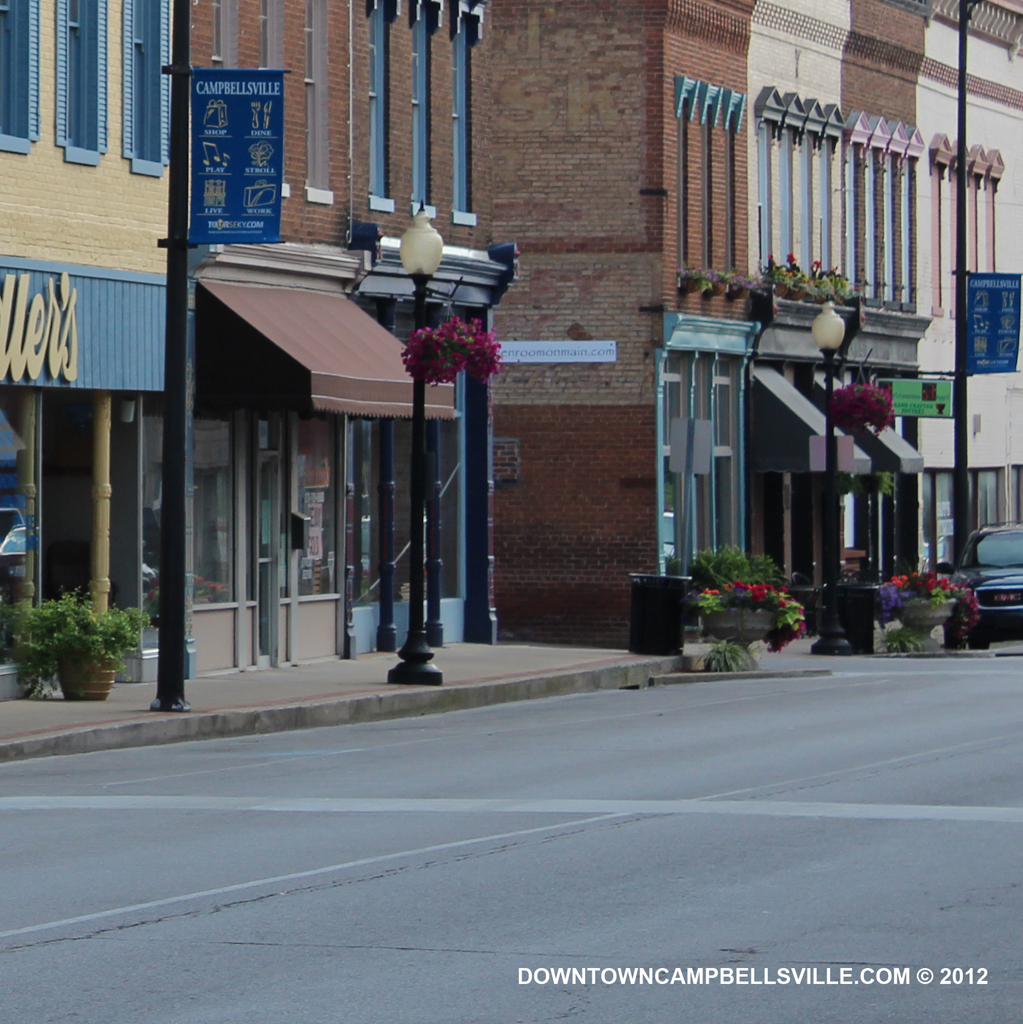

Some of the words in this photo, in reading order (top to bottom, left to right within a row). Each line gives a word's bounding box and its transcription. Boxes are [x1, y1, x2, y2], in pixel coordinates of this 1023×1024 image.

[196, 81, 281, 95] CAMPBELLSVILLE
[970, 279, 1020, 289] CAMPBELLSVILLE
[496, 346, 616, 358] enroomonmain.com
[994, 592, 1021, 601] GMC
